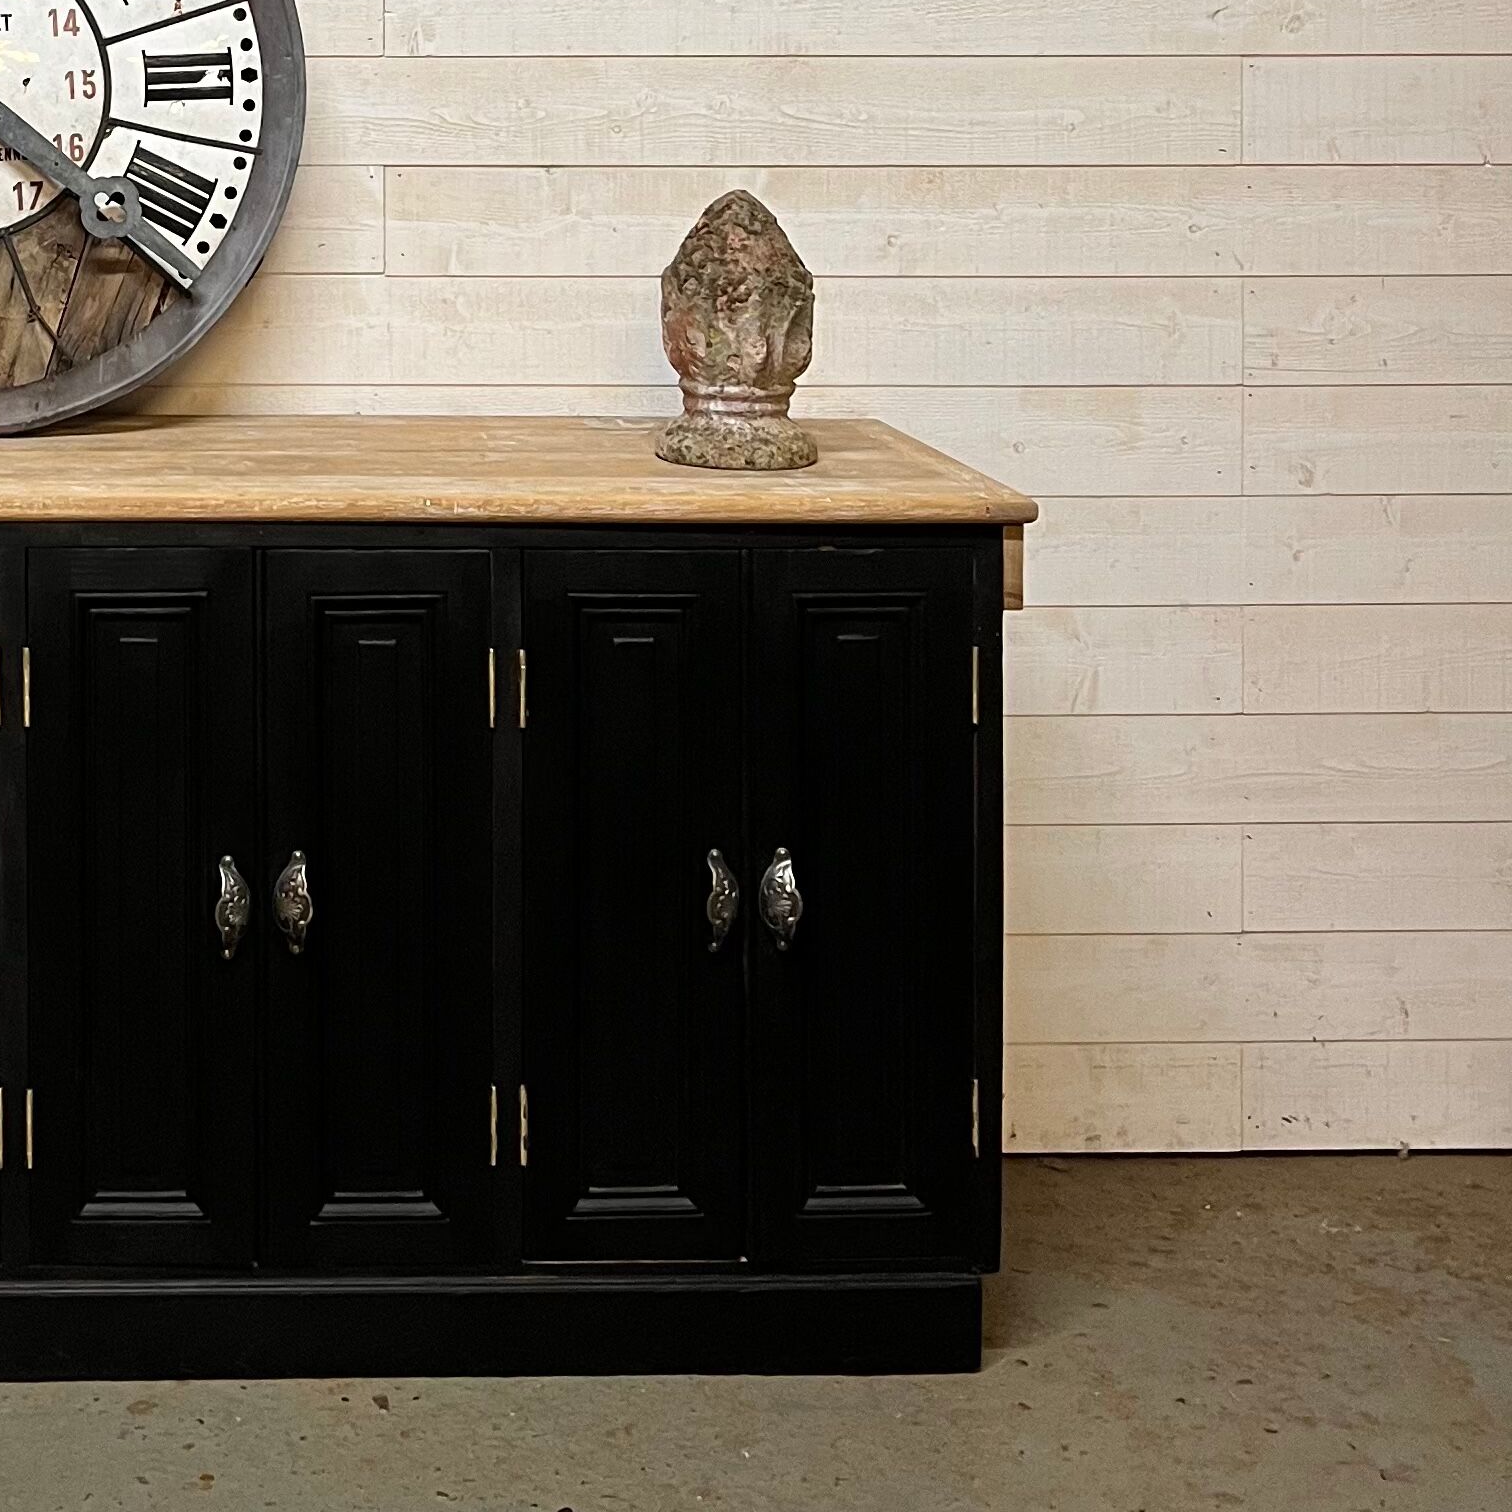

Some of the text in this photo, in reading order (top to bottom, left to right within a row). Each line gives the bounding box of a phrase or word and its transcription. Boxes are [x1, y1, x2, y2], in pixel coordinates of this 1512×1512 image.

[48, 8, 81, 37] 14
[64, 69, 97, 100] 15
[142, 47, 234, 107] III
[12, 181, 44, 211] 17
[123, 140, 218, 246] IIII
